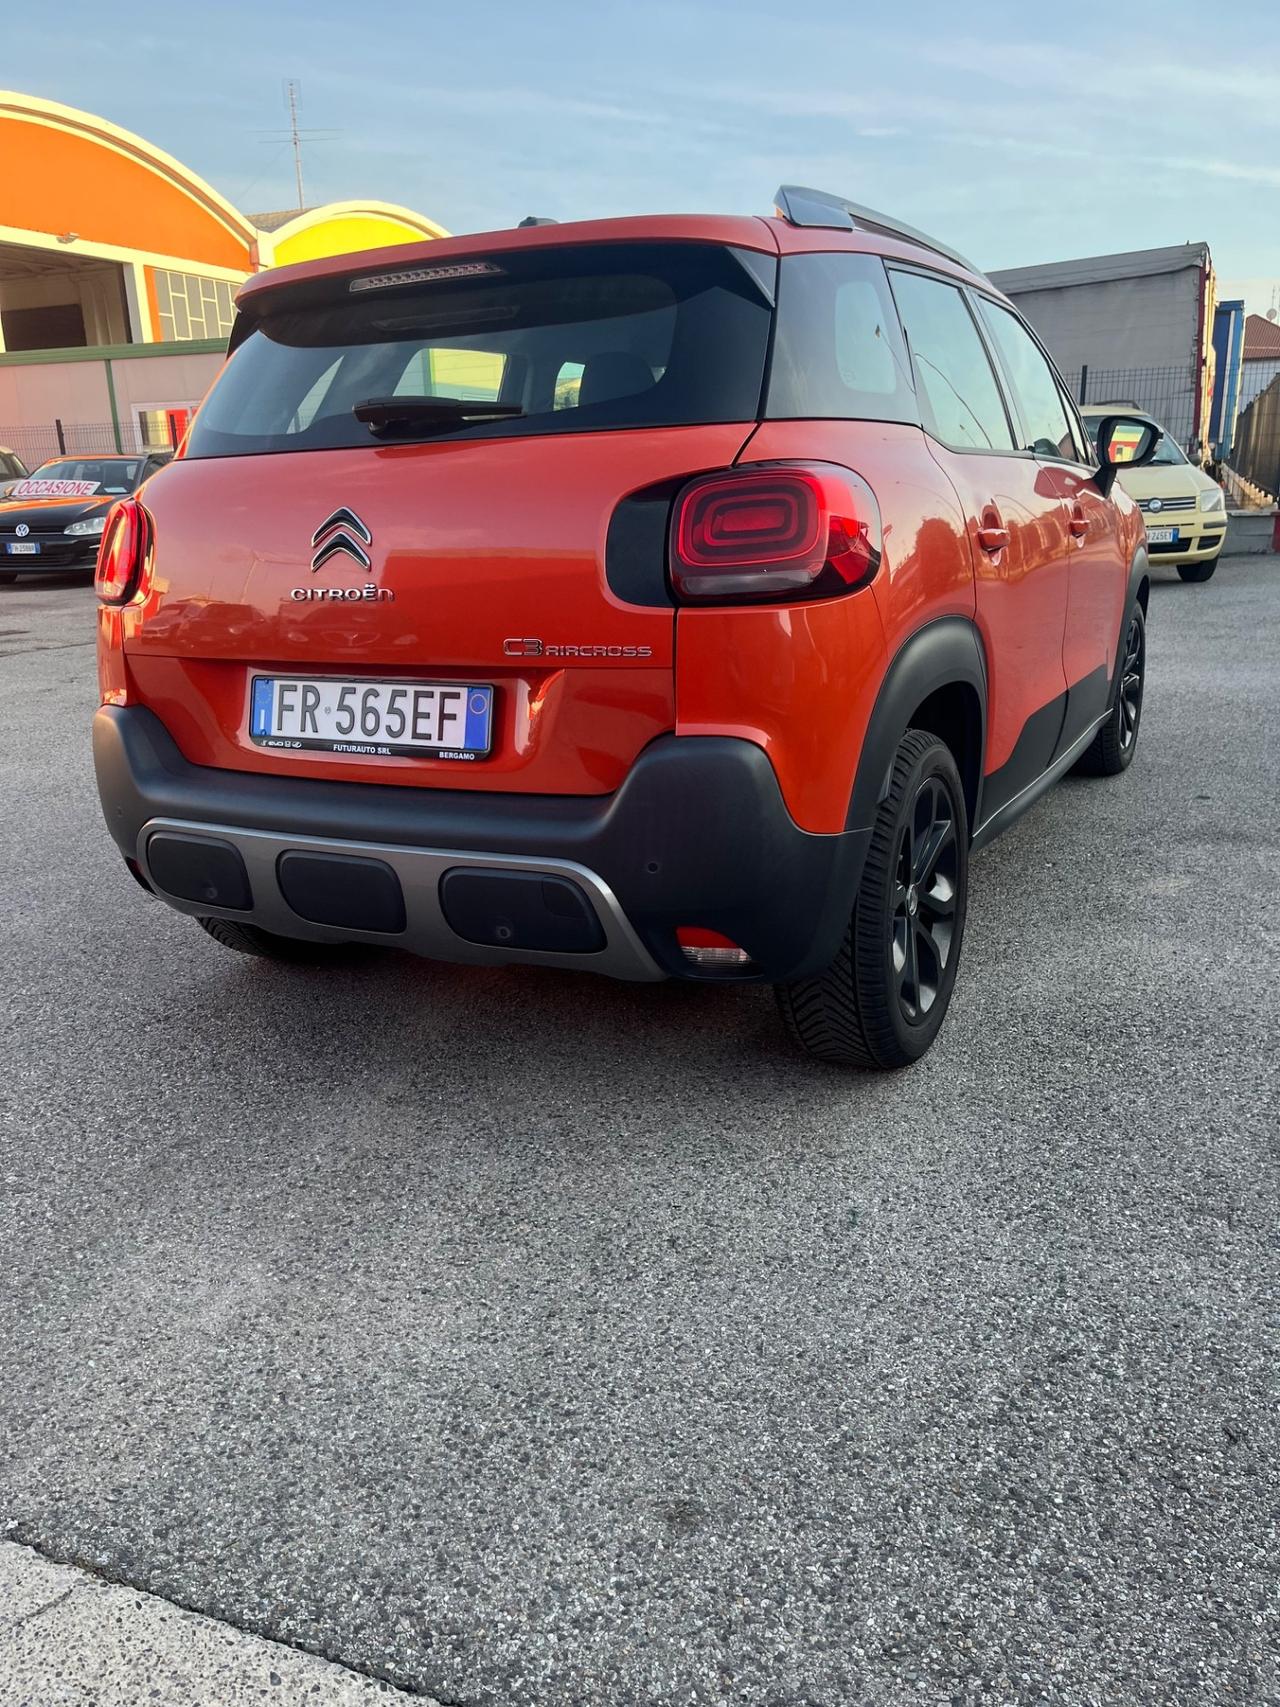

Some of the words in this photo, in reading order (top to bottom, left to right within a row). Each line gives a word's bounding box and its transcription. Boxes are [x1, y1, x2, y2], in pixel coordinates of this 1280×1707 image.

[18, 481, 95, 495] OCCASIONE
[290, 583, 394, 601] CITROËN
[503, 638, 542, 656] C3
[545, 645, 652, 657] AIRCROSS
[277, 684, 320, 733] FR
[335, 686, 461, 741] 565EF
[333, 744, 376, 754] FUTURAUTO
[377, 747, 391, 755] SRL
[439, 751, 475, 760] BERGAMO
